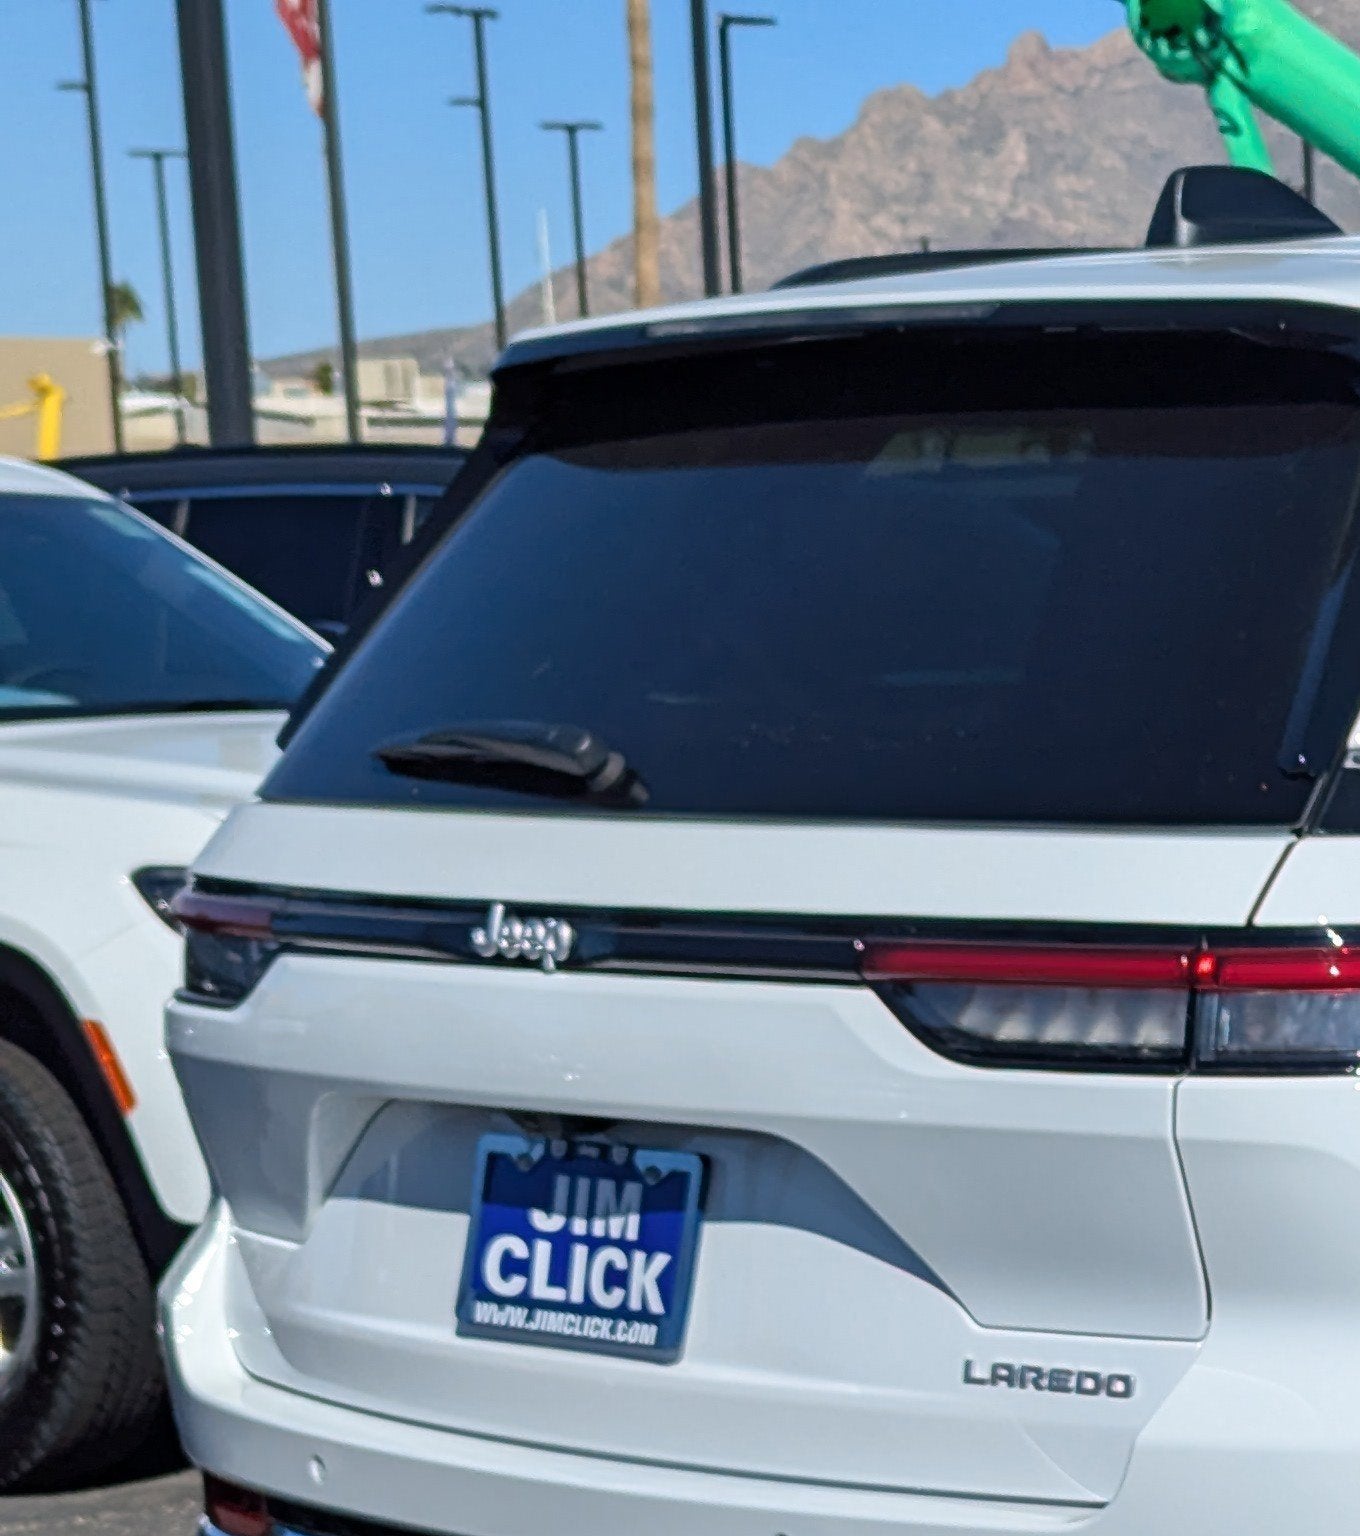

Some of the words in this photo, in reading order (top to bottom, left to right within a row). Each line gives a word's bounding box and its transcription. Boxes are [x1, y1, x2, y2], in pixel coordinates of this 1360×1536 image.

[470, 902, 575, 972] Jeep
[527, 1173, 644, 1242] JIM
[480, 1232, 673, 1316] CLICK
[471, 1299, 660, 1347] WWW.JIMCLICK.COM
[962, 1359, 1136, 1399] LAREDO
